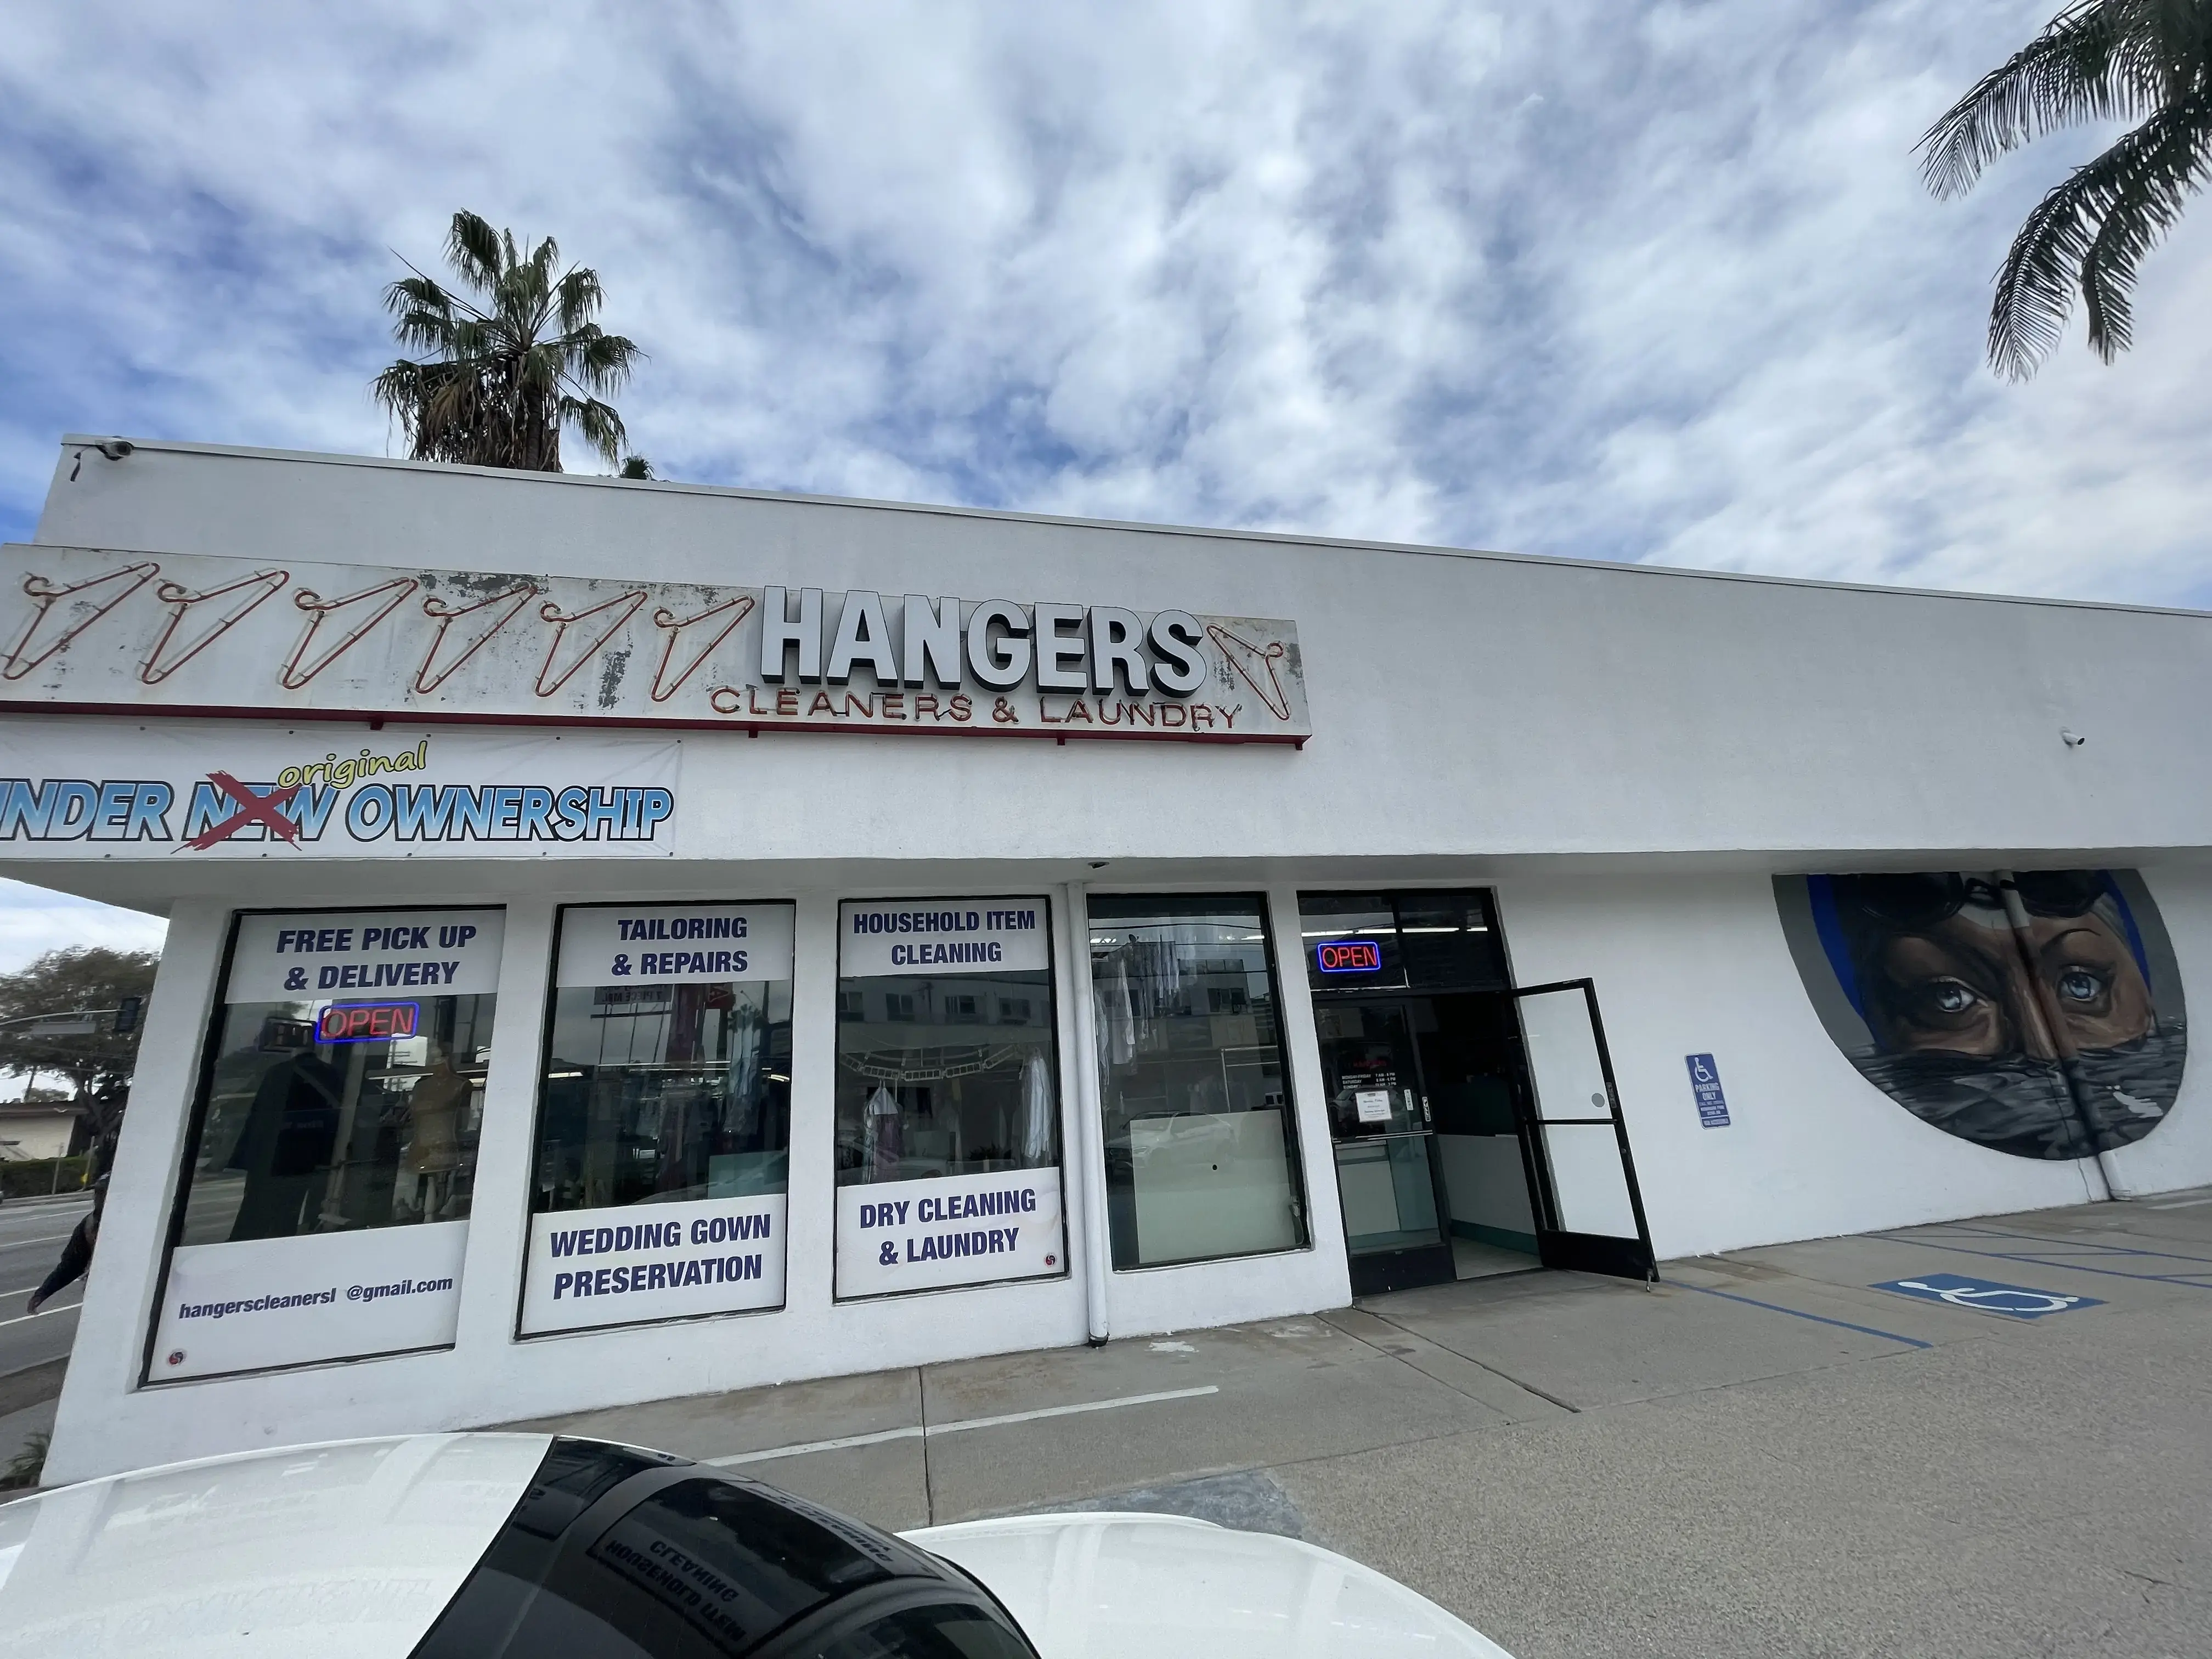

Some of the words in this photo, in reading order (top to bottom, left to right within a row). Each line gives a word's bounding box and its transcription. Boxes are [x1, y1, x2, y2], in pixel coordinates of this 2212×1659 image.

[760, 585, 1207, 698] HANGERS
[710, 685, 973, 722] CLEANERS
[992, 696, 1019, 723] &
[1040, 696, 1243, 730] LAUNDRY
[277, 740, 428, 789] original
[0, 778, 174, 842] NDER
[345, 784, 674, 842] OWNERSHIP
[618, 917, 748, 941] TAILORING
[853, 911, 979, 934] HOUSEHOLD
[986, 910, 1036, 930] ITEM
[276, 928, 354, 953] FREE
[361, 926, 432, 951] PICK
[439, 926, 477, 947] UP
[891, 942, 1002, 966] CLEANING
[611, 953, 631, 975] &
[640, 950, 748, 974] REPAIRS
[1322, 946, 1378, 968] OPEN
[284, 967, 308, 990] &
[318, 961, 460, 989] DELIVERY
[320, 1007, 415, 1038] OPEN
[1695, 1082, 1720, 1092] PARKING
[860, 1200, 910, 1229] DRY
[918, 1188, 1037, 1223] CLEANING
[550, 1220, 681, 1258] WEDDING
[690, 1214, 771, 1245] GOWN
[879, 1241, 899, 1266] &
[906, 1227, 1021, 1263] LAUNDRY
[346, 1277, 453, 1303] @gmail.com
[553, 1254, 763, 1300] PRESERVATION
